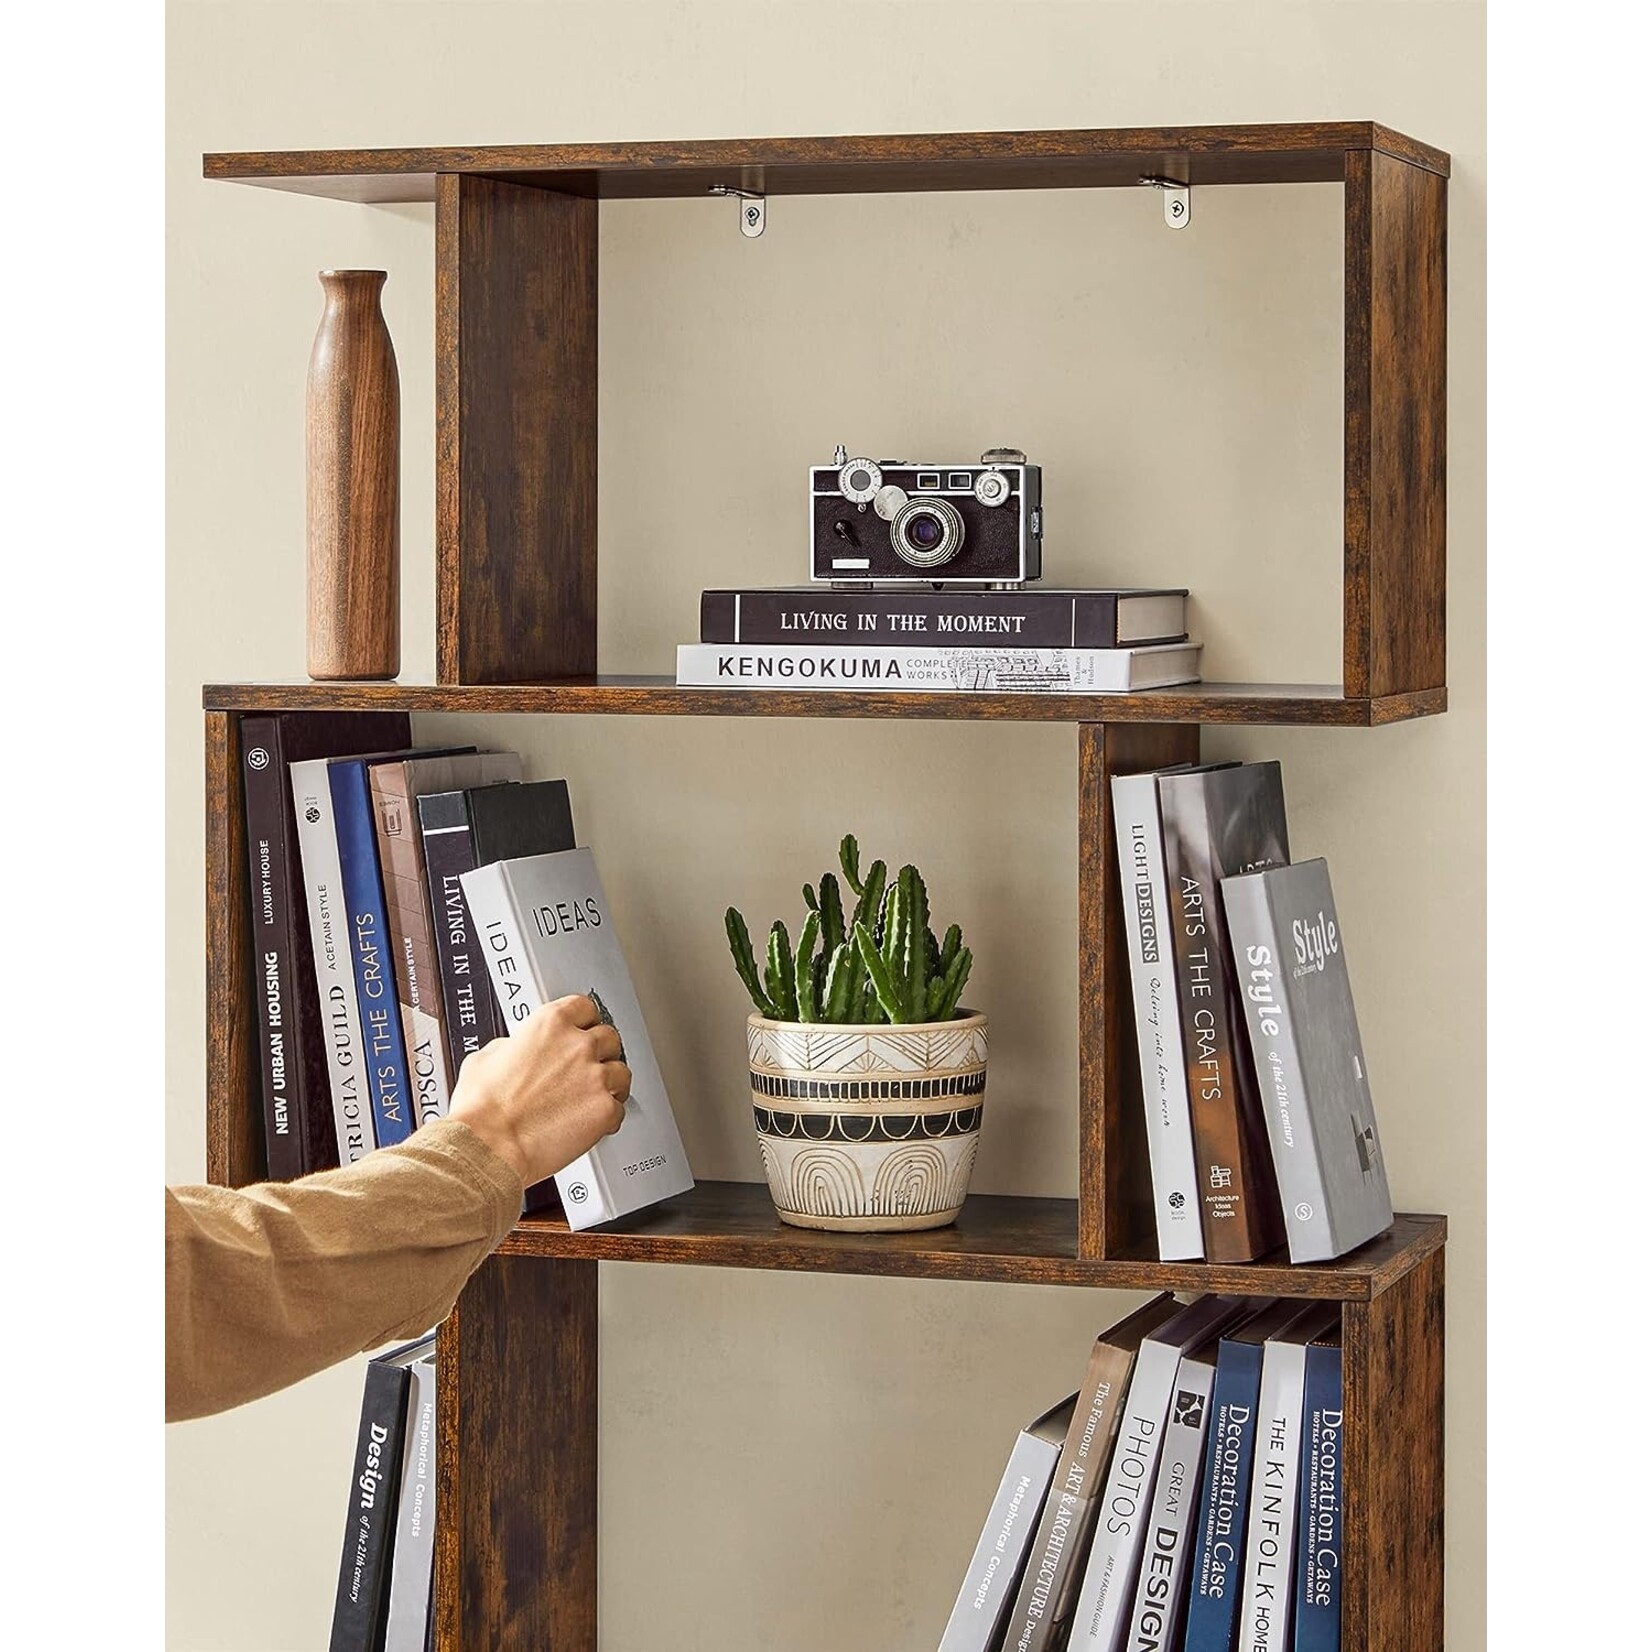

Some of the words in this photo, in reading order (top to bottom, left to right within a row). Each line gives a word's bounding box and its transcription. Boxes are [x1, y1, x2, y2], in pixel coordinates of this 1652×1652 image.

[781, 611, 847, 630] LIVING
[857, 614, 878, 631] IN
[886, 614, 928, 632] THE
[937, 615, 1026, 633] MOMENT
[718, 657, 902, 679] KENGOKUMA
[906, 670, 947, 680] WORKS
[259, 840, 271, 879] HOUSE
[1131, 824, 1149, 883] LIGHT
[262, 880, 274, 925] LUXURY
[317, 884, 332, 920] STYLE
[443, 875, 466, 945] LIVING
[532, 897, 602, 937] IDEAS
[1138, 884, 1157, 963] DESIGNS
[1181, 876, 1205, 937] ARTS
[356, 913, 384, 998] CRAFTS
[452, 953, 470, 975] IN
[1292, 911, 1338, 971] Style
[265, 952, 282, 1026] HOUSING
[486, 922, 530, 1022] IDEAS
[1189, 948, 1212, 997] THE
[1246, 945, 1282, 1036] Style
[329, 985, 353, 1066] GUILD
[457, 983, 477, 1027] THE
[369, 1009, 390, 1057] THE
[1194, 1009, 1222, 1101] CRAFTS
[270, 1033, 286, 1090] URBAN
[1268, 1051, 1282, 1065] of
[1273, 1066, 1284, 1082] the
[274, 1097, 290, 1135] NEW
[379, 1066, 401, 1122] ARTS
[1281, 1108, 1294, 1148] century
[623, 1166, 638, 1177] TOP
[640, 1154, 667, 1172] DESIGN
[1093, 1382, 1110, 1406] The
[417, 1403, 433, 1479] Metaphorical
[1217, 1406, 1227, 1438] HOTELS
[1270, 1418, 1286, 1451] THE
[1312, 1411, 1321, 1444] HOTELS
[359, 1422, 388, 1510] Design
[1065, 1462, 1086, 1495] ART
[1106, 1416, 1155, 1537] PHOTOS
[1211, 1444, 1223, 1501] RESTAURANTS
[1216, 1404, 1250, 1536] Decoration
[1309, 1450, 1318, 1508] RESTAURANTS
[1317, 1409, 1343, 1543] Decoration
[411, 1485, 426, 1537] Concepts
[1061, 1493, 1077, 1505] &
[1165, 1462, 1186, 1518] GREAT
[359, 1528, 369, 1544] the
[360, 1515, 370, 1529] of
[995, 1475, 1031, 1552] Metaphorical
[1207, 1509, 1216, 1547] GARDENS
[1255, 1461, 1285, 1600] KINFOLK
[1308, 1516, 1316, 1554] GARDENS
[349, 1566, 361, 1603] century
[973, 1557, 1000, 1611] Concepts
[1027, 1505, 1074, 1619] ARCHITECTURE
[1106, 1554, 1115, 1572] ART
[1200, 1552, 1210, 1596] GETAWAYS
[1209, 1543, 1234, 1599] Case
[1305, 1560, 1314, 1604] GETAWAYS
[1316, 1550, 1338, 1607] Case
[1096, 1578, 1109, 1612] FASHION
[1089, 1612, 1102, 1638] GUIDE
